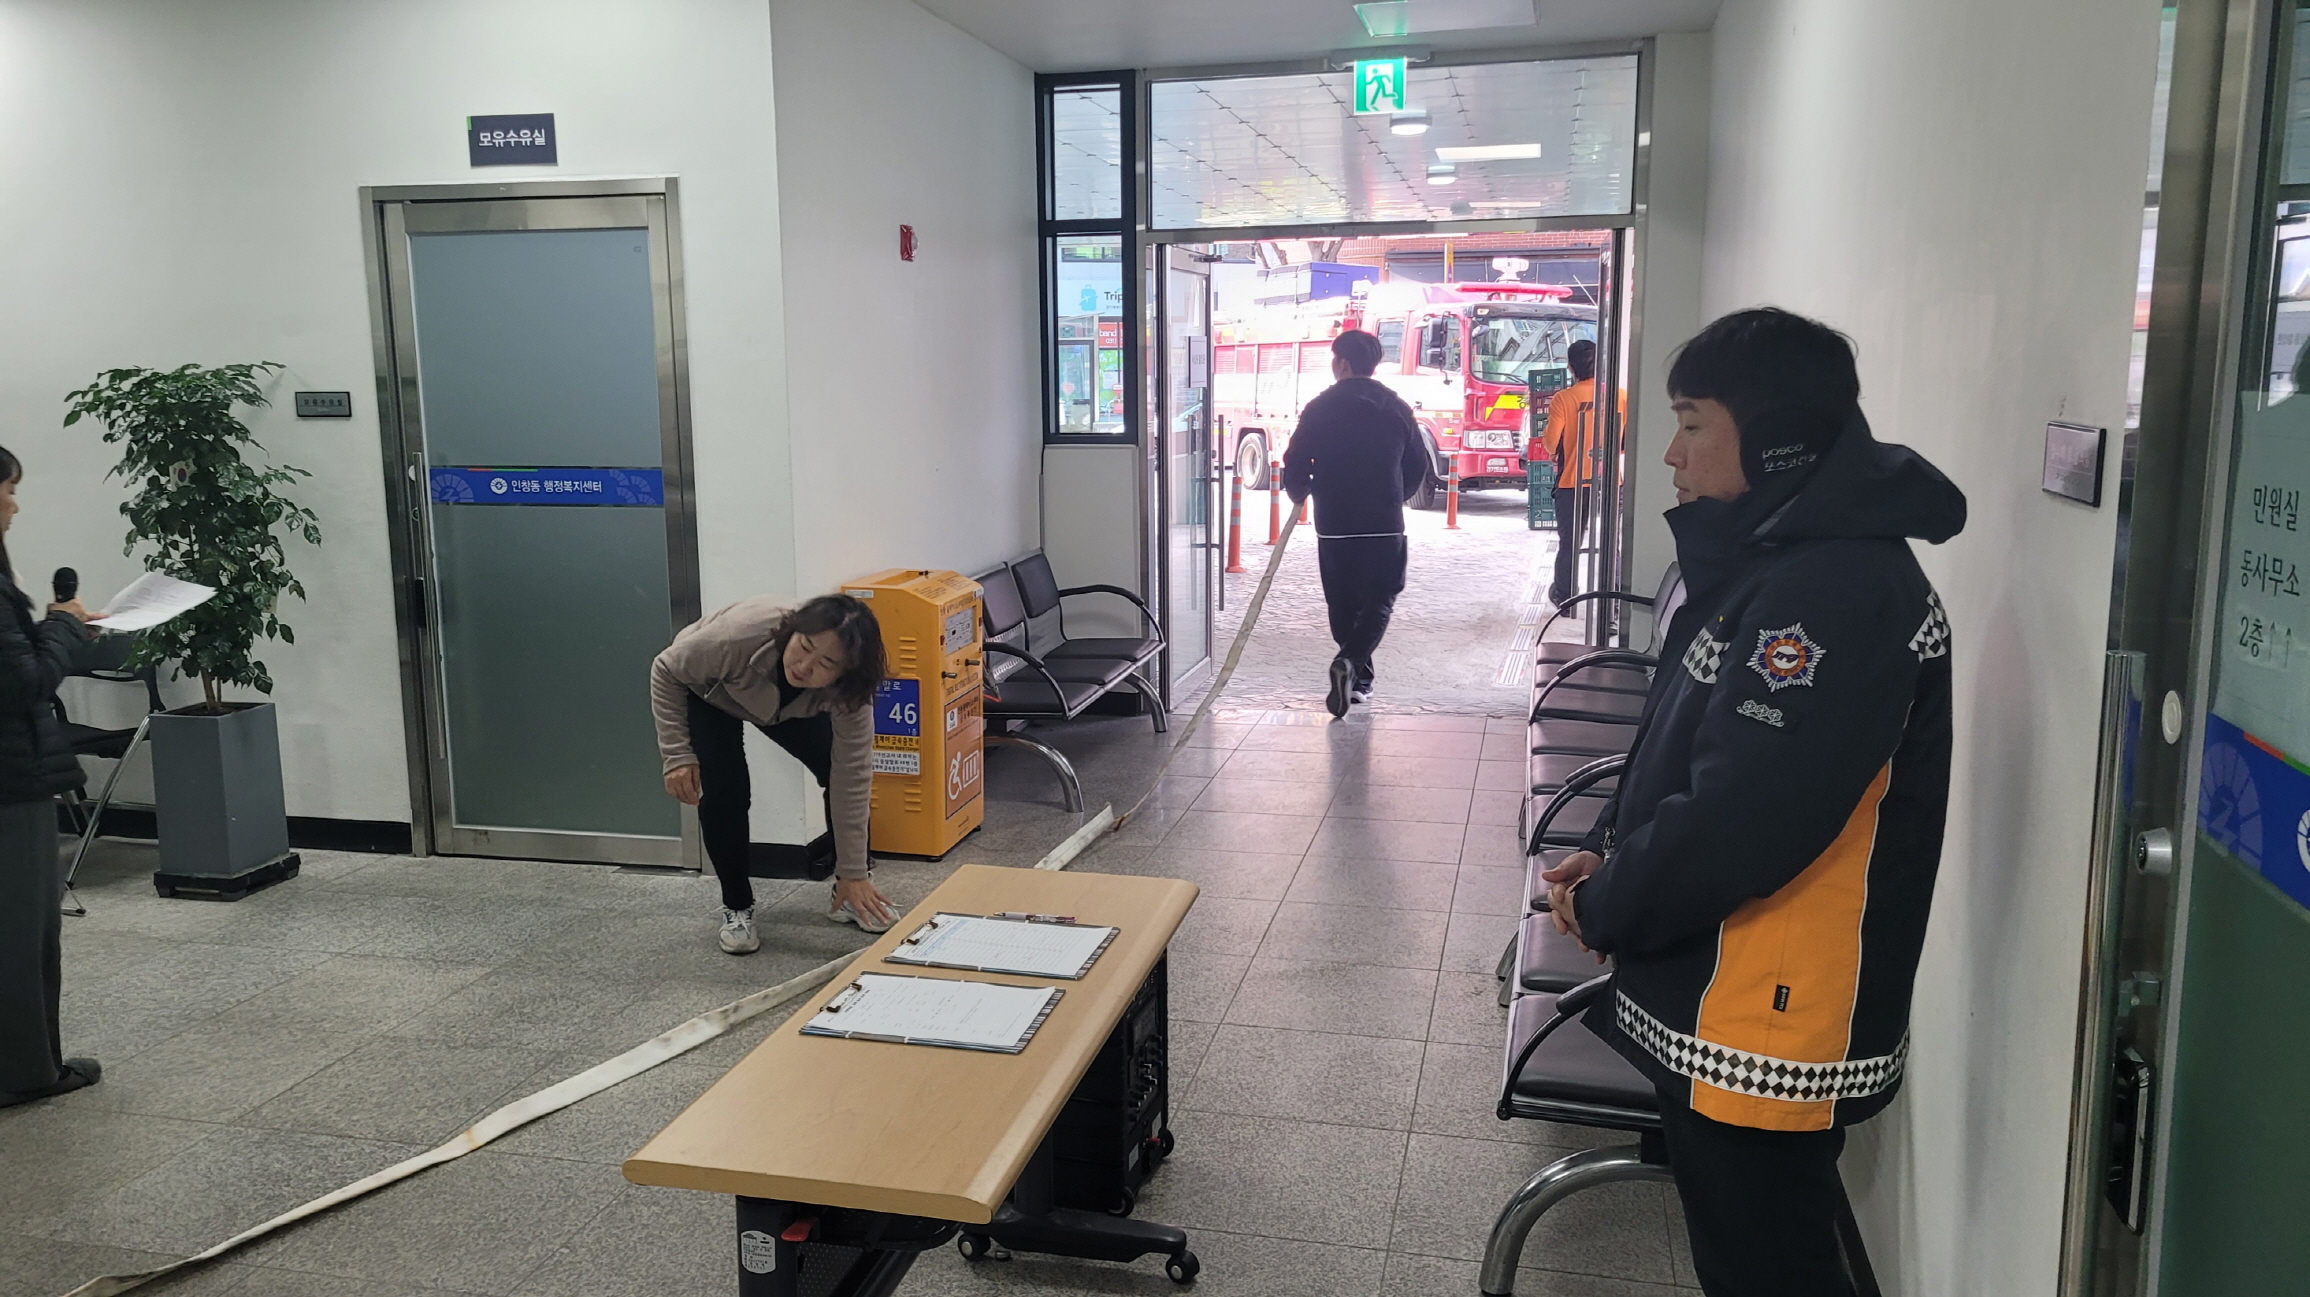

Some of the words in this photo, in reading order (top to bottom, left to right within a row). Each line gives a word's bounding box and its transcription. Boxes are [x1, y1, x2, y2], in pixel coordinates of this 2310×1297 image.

[478, 128, 546, 148] 모유수유실
[1762, 444, 1804, 461] posco
[511, 479, 540, 493] 인창동
[543, 479, 602, 494] 행정복지센터
[2253, 485, 2300, 532] 민원실
[2240, 549, 2301, 597] 동사무소
[2239, 615, 2264, 658] 2층
[888, 702, 917, 725] 46
